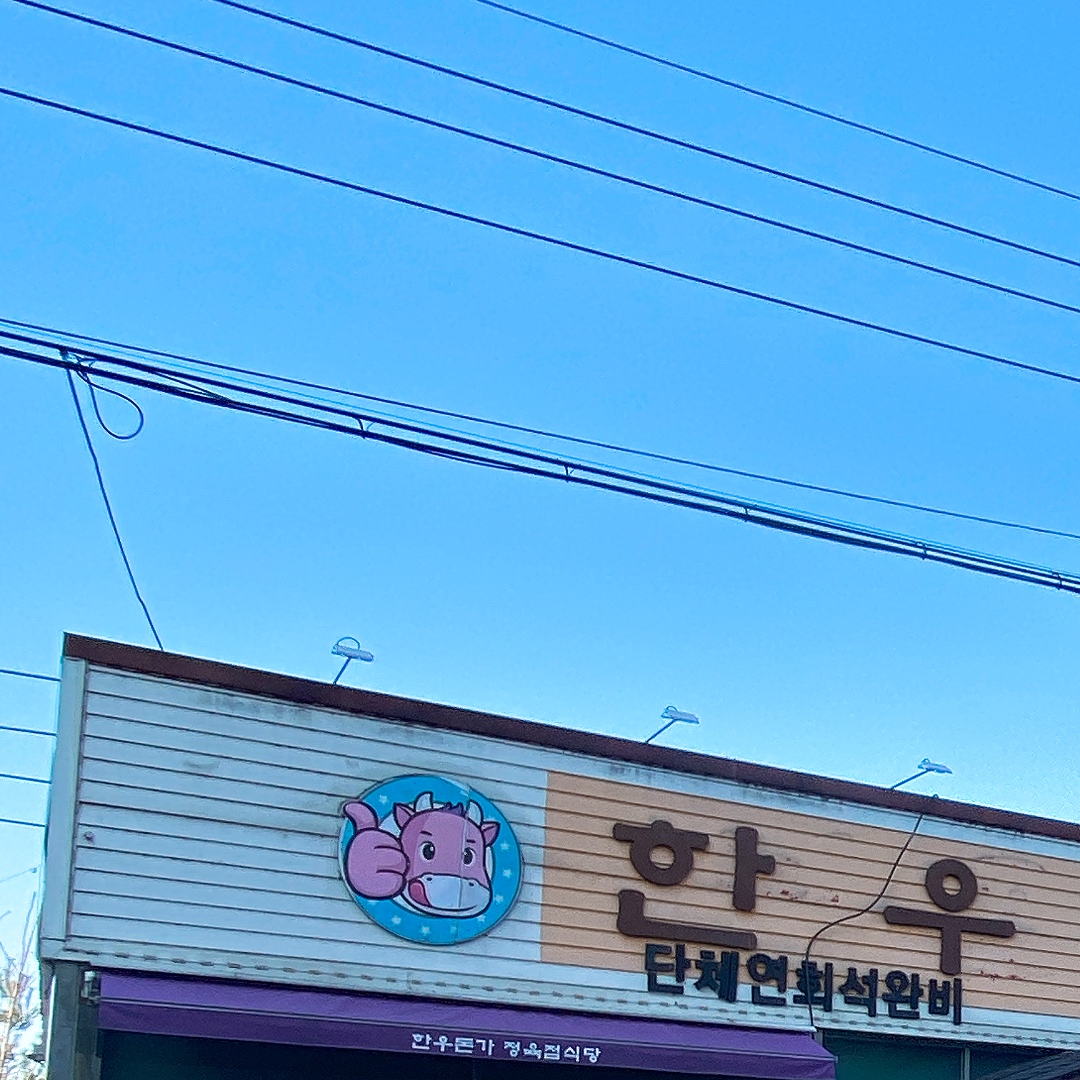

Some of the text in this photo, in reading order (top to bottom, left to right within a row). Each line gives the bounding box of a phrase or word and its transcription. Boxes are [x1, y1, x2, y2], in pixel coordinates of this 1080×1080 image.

[643, 943, 962, 1025] 단체연회석완비
[411, 1033, 602, 1064] 한우돈가 정육점식당
